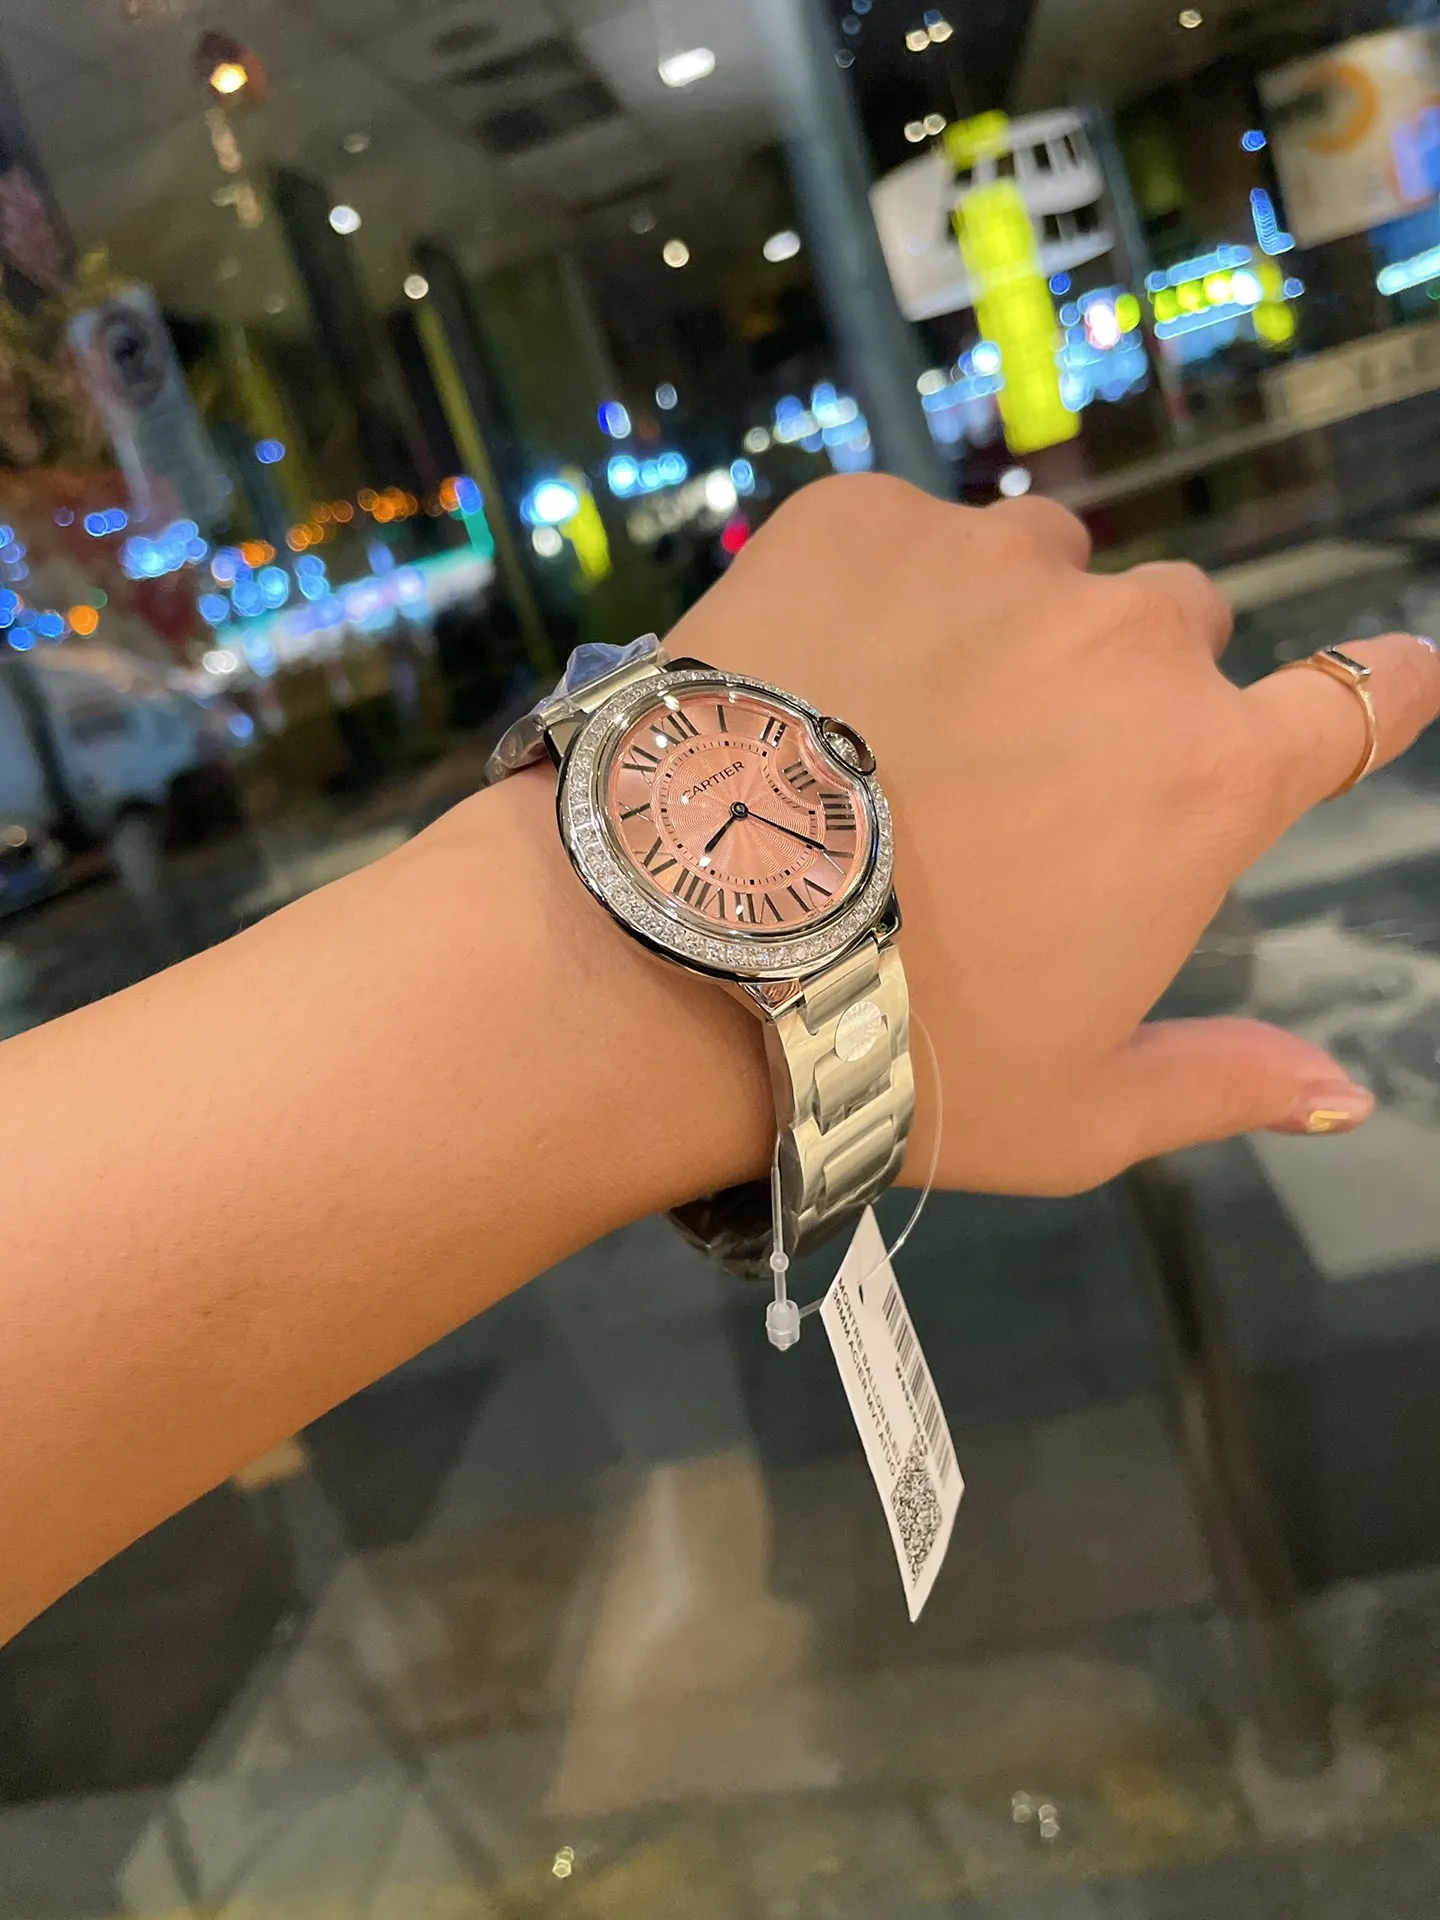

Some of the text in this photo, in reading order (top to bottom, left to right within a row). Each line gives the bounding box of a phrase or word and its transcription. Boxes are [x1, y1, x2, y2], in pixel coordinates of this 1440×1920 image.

[682, 761, 745, 800] CARTIER
[838, 1276, 864, 1351] MONTRE
[862, 1352, 886, 1420] BALLON
[848, 1340, 867, 1391] ACIER
